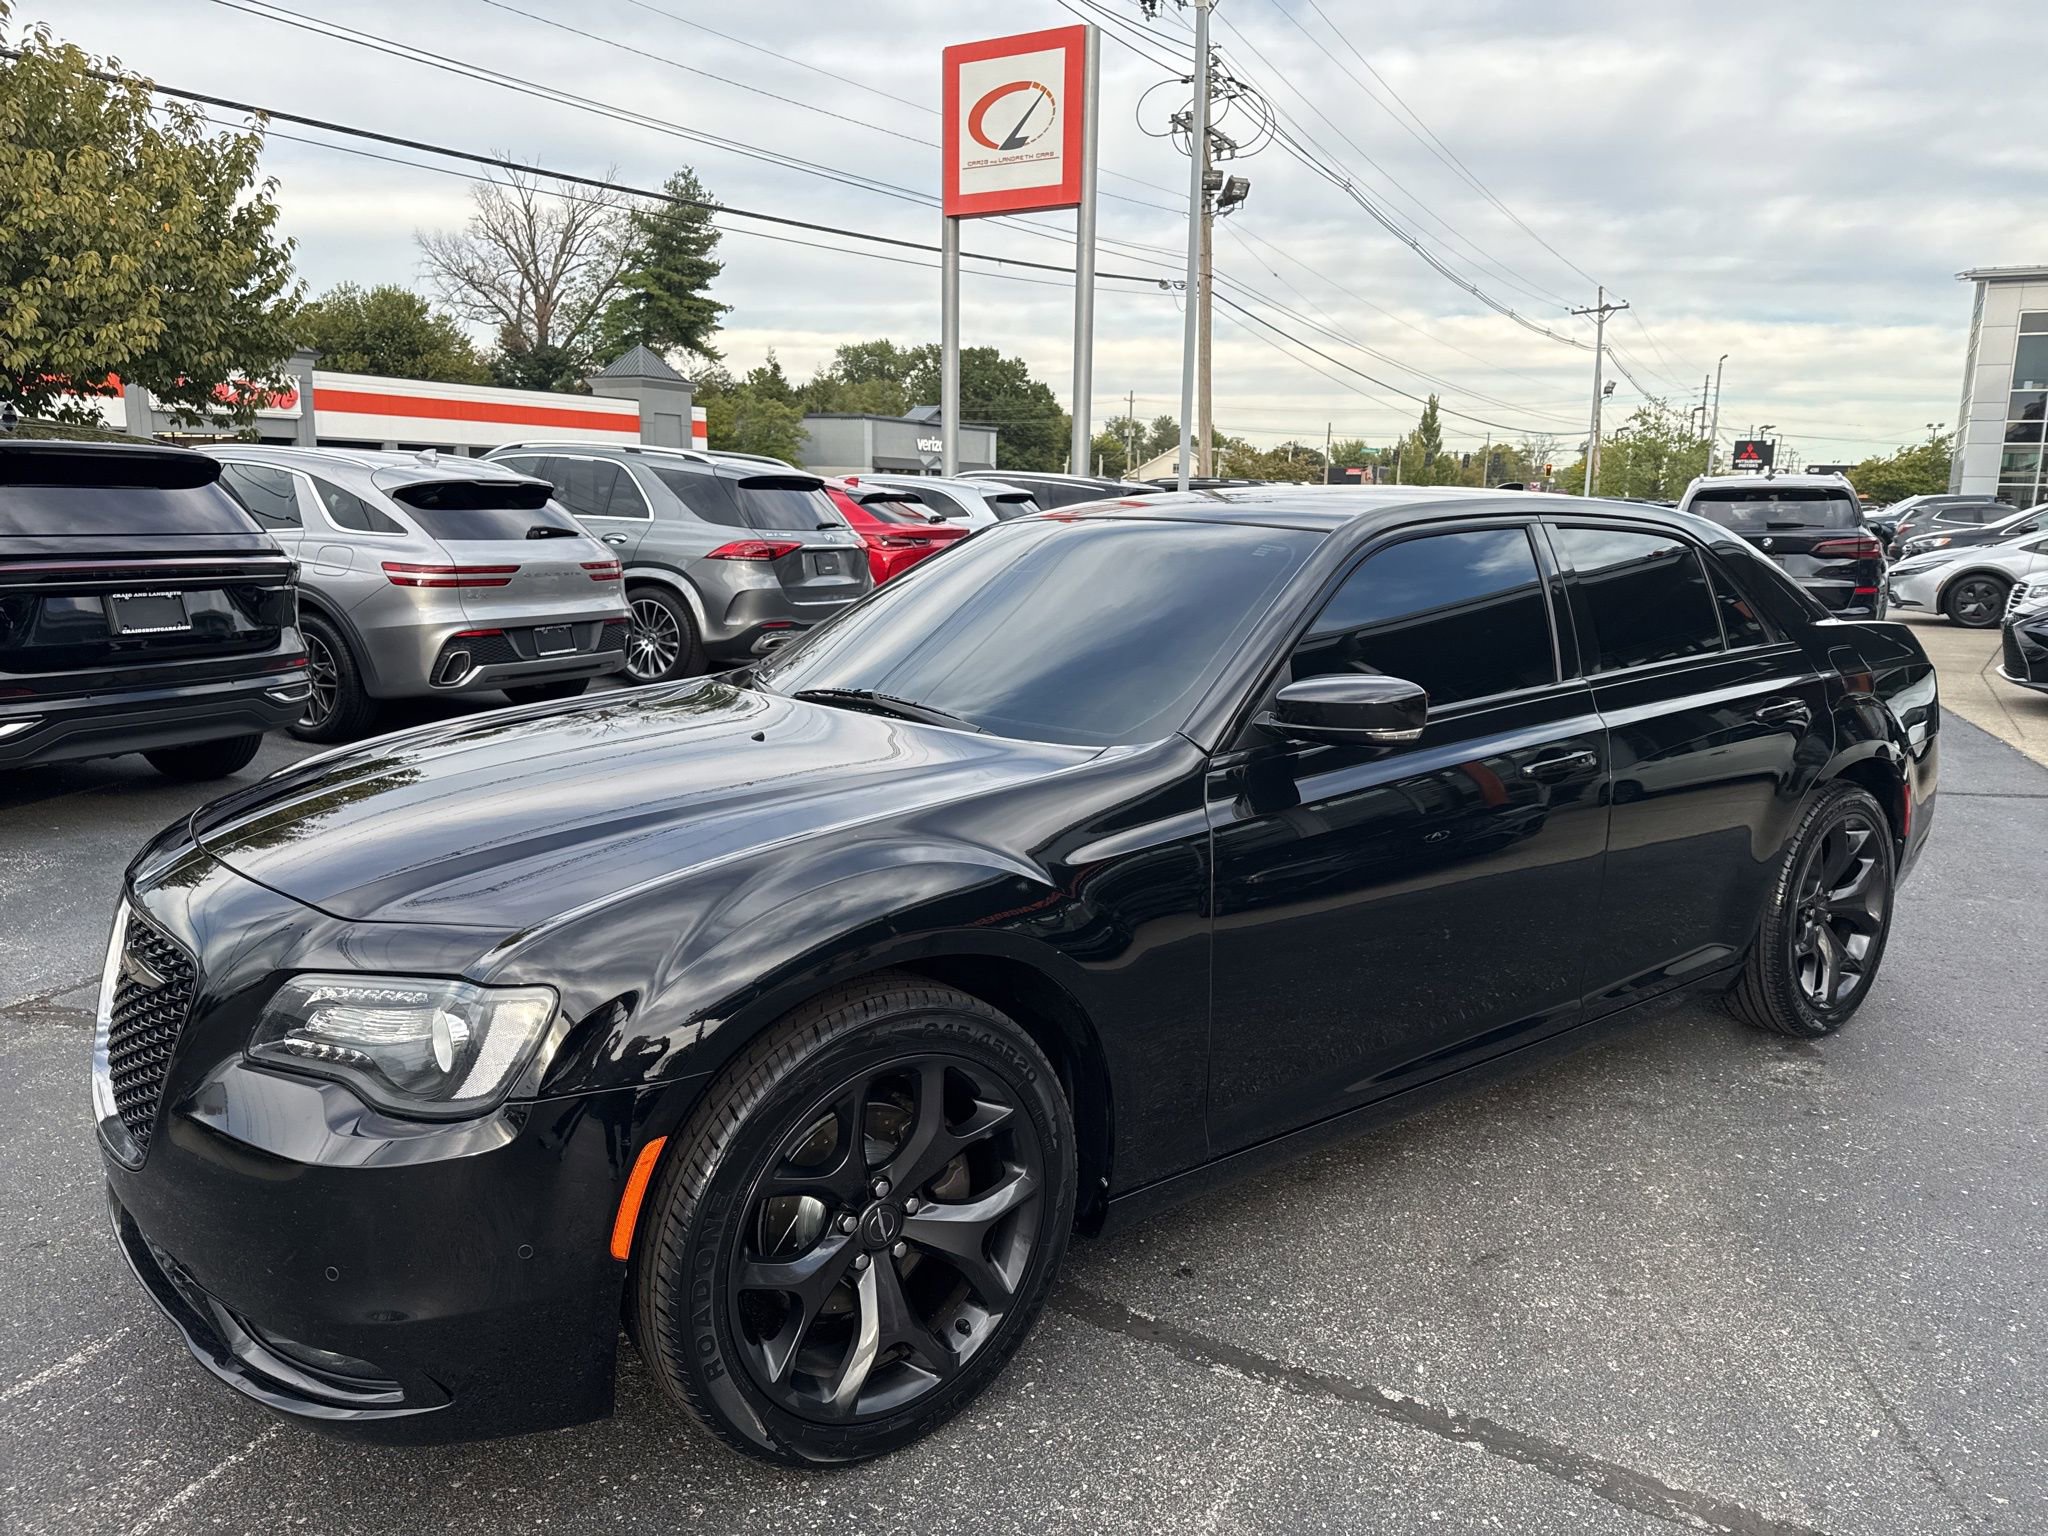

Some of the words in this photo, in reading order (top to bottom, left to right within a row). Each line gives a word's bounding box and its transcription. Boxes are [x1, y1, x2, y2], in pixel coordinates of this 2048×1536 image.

[998, 154, 1034, 163] LANDRETH
[1035, 151, 1055, 159] CARS
[691, 1190, 731, 1383] ROADONE
